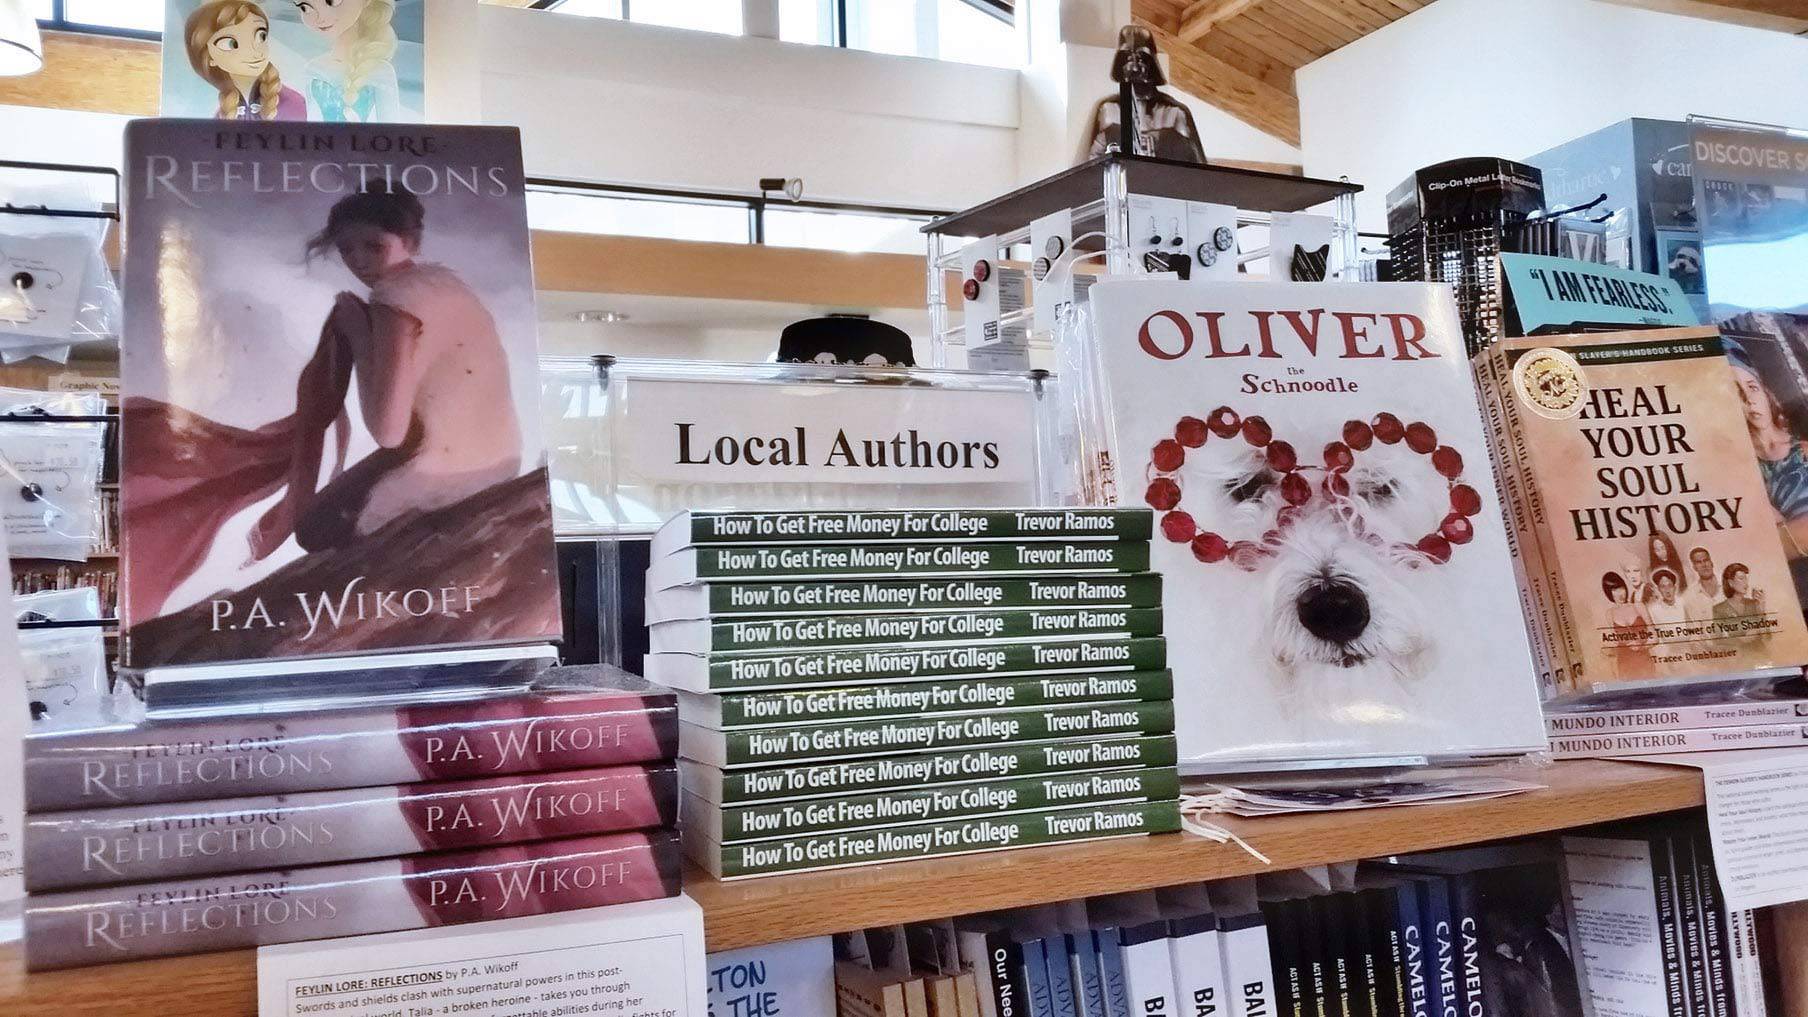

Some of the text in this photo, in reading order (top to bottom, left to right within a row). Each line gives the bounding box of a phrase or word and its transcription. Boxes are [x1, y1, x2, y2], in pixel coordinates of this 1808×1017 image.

[214, 131, 437, 157] FEYLIN LORE
[1695, 141, 1808, 171] DISCOVER S
[145, 154, 509, 208] REFLECTIONS
[1428, 180, 1463, 192] Clip-On
[1465, 173, 1490, 186] Metal
[1552, 270, 1587, 303] AM
[1138, 308, 1442, 361] OLIVER
[1622, 346, 1671, 358] HANDBOOK
[1672, 343, 1705, 353] SERIES
[1240, 373, 1359, 395] Schnoodle
[1287, 366, 1305, 376] the
[1579, 384, 1682, 420] HEAL
[674, 422, 1000, 470] Local Authors
[1478, 363, 1493, 398] HEAL
[1487, 400, 1503, 436] YOUR
[1497, 438, 1511, 473] SOUL
[1505, 475, 1528, 533] HISTORY
[1494, 354, 1508, 390] HEAL
[1503, 392, 1518, 427] YOUR
[1513, 430, 1527, 465] SOUL
[1521, 468, 1545, 525] HISTORY
[1580, 423, 1695, 459] YOUR
[1597, 462, 1700, 500] SOUL
[714, 512, 1115, 535] How To Get Free Money For College Trevor Ramos
[1569, 496, 1744, 541] HISTORY
[211, 576, 481, 641] P.A. WIKOFF
[731, 581, 1127, 605] How To Get Free Money For College Trevor Ramos
[1602, 618, 1778, 642] Activate the True Power of Your Shadow
[1652, 654, 1683, 664] Tracee
[750, 708, 1138, 755] How To Get Free Money For College Trevor Ramos
[1552, 707, 1789, 731] MUNDO INTERIOR Tracee Dunblazier
[1559, 729, 1795, 753] MUNDO INTERIOR Tracee Dunblazier
[82, 719, 629, 800] REFLECTIONS P.A. WIKOFF
[82, 822, 334, 875] REFLECTIONS
[426, 803, 484, 832] P.A.
[490, 785, 627, 837] WIKOFF
[85, 860, 632, 951] REFLECTIONS P.A. WIKOFF
[1664, 923, 1676, 959] Movies
[1688, 921, 1700, 958] Movies
[1706, 911, 1719, 947] Movies
[295, 961, 519, 997] FEYLIN LORE: REFLECTIONS by P.A. Wikoff
[707, 960, 766, 993] TON
[995, 949, 1007, 980] Our
[1461, 917, 1483, 1017] CAMELO
[1712, 959, 1725, 992] Minds
[295, 966, 623, 1014] Swords and shields clash with supernatural powers in this post-
[408, 1007, 433, 1017] Talia
[452, 1000, 489, 1013] broken
[491, 995, 531, 1009] heroine
[541, 989, 567, 1002] takes
[570, 988, 588, 1000] you
[590, 981, 631, 997] through
[727, 992, 779, 1017] THE
[1669, 972, 1682, 1004] Minds
[1693, 970, 1704, 1003] Minds
[551, 1004, 589, 1017] abilities
[592, 1000, 623, 1016] during
[626, 997, 643, 1007] her
